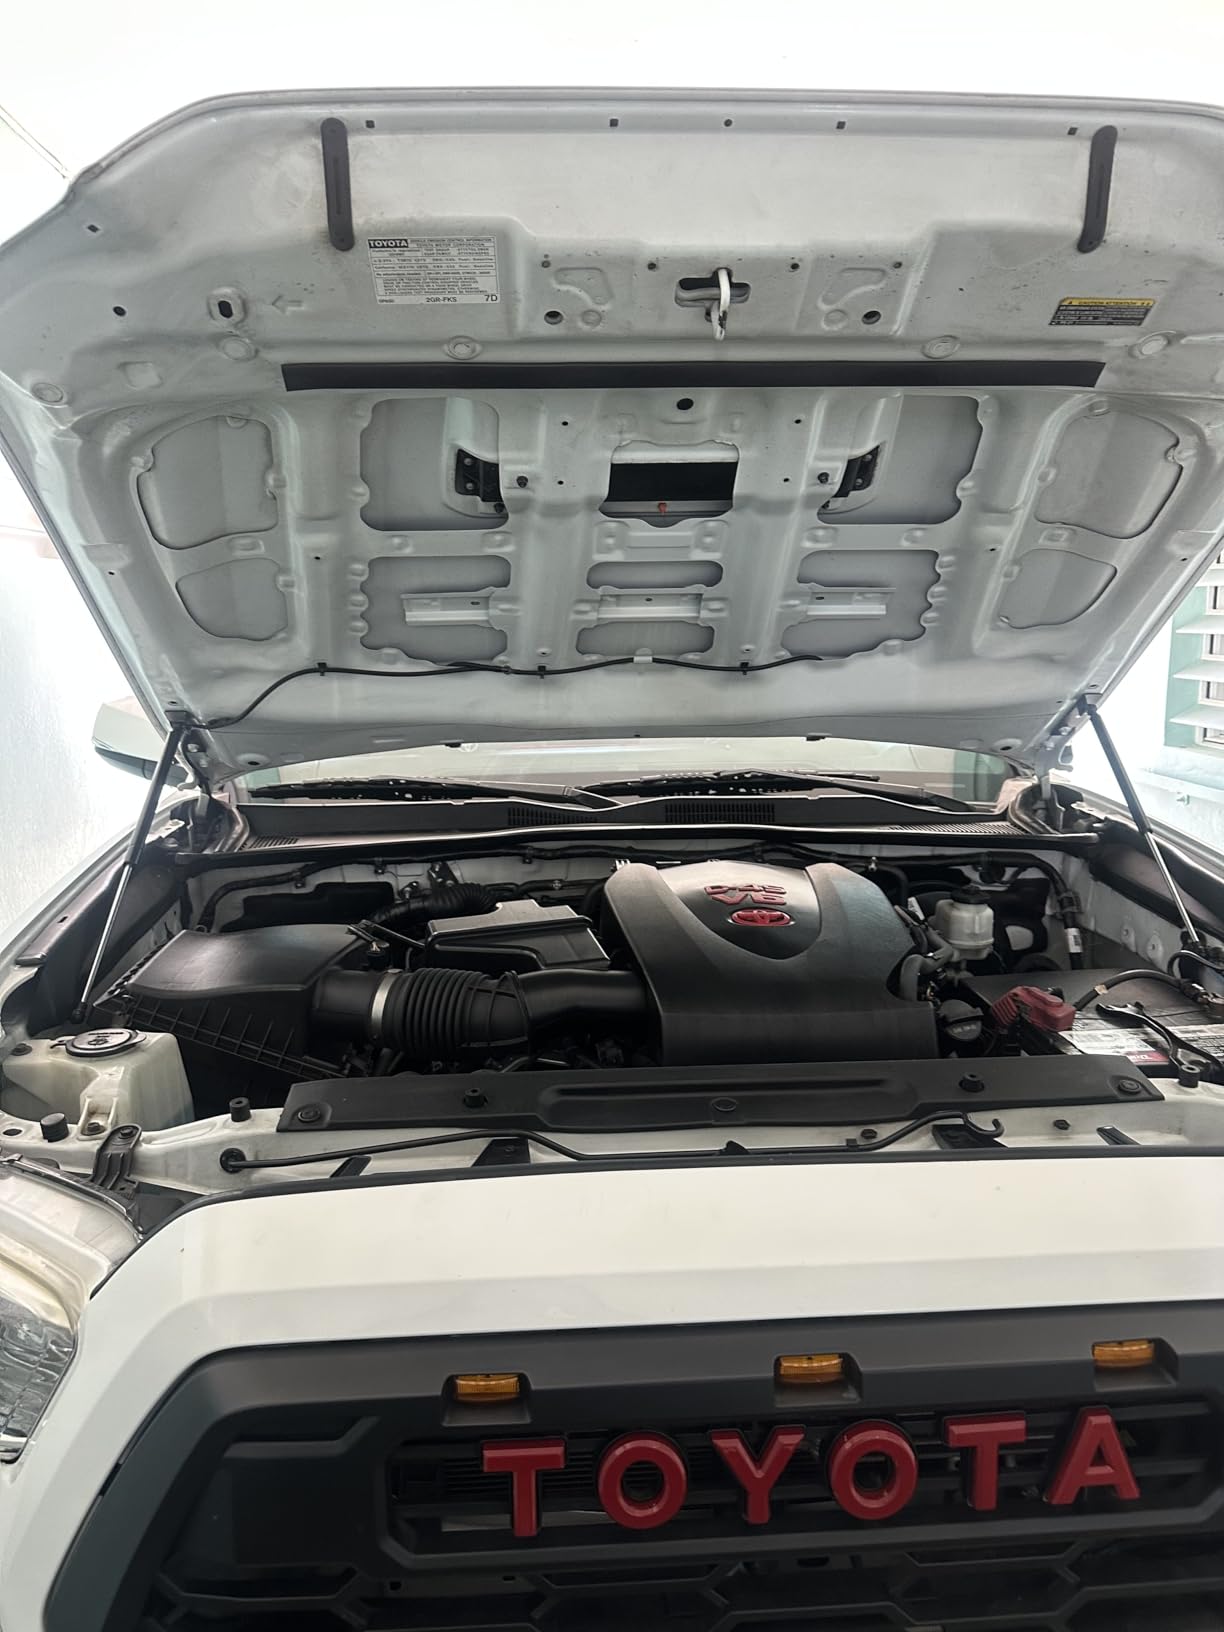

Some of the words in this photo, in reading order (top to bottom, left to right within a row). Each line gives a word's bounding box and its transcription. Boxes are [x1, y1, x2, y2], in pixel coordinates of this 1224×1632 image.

[369, 239, 408, 248] TOYOTA
[484, 294, 498, 302] 7D
[711, 892, 787, 906] V6
[482, 1407, 1141, 1537] TOYOTA
